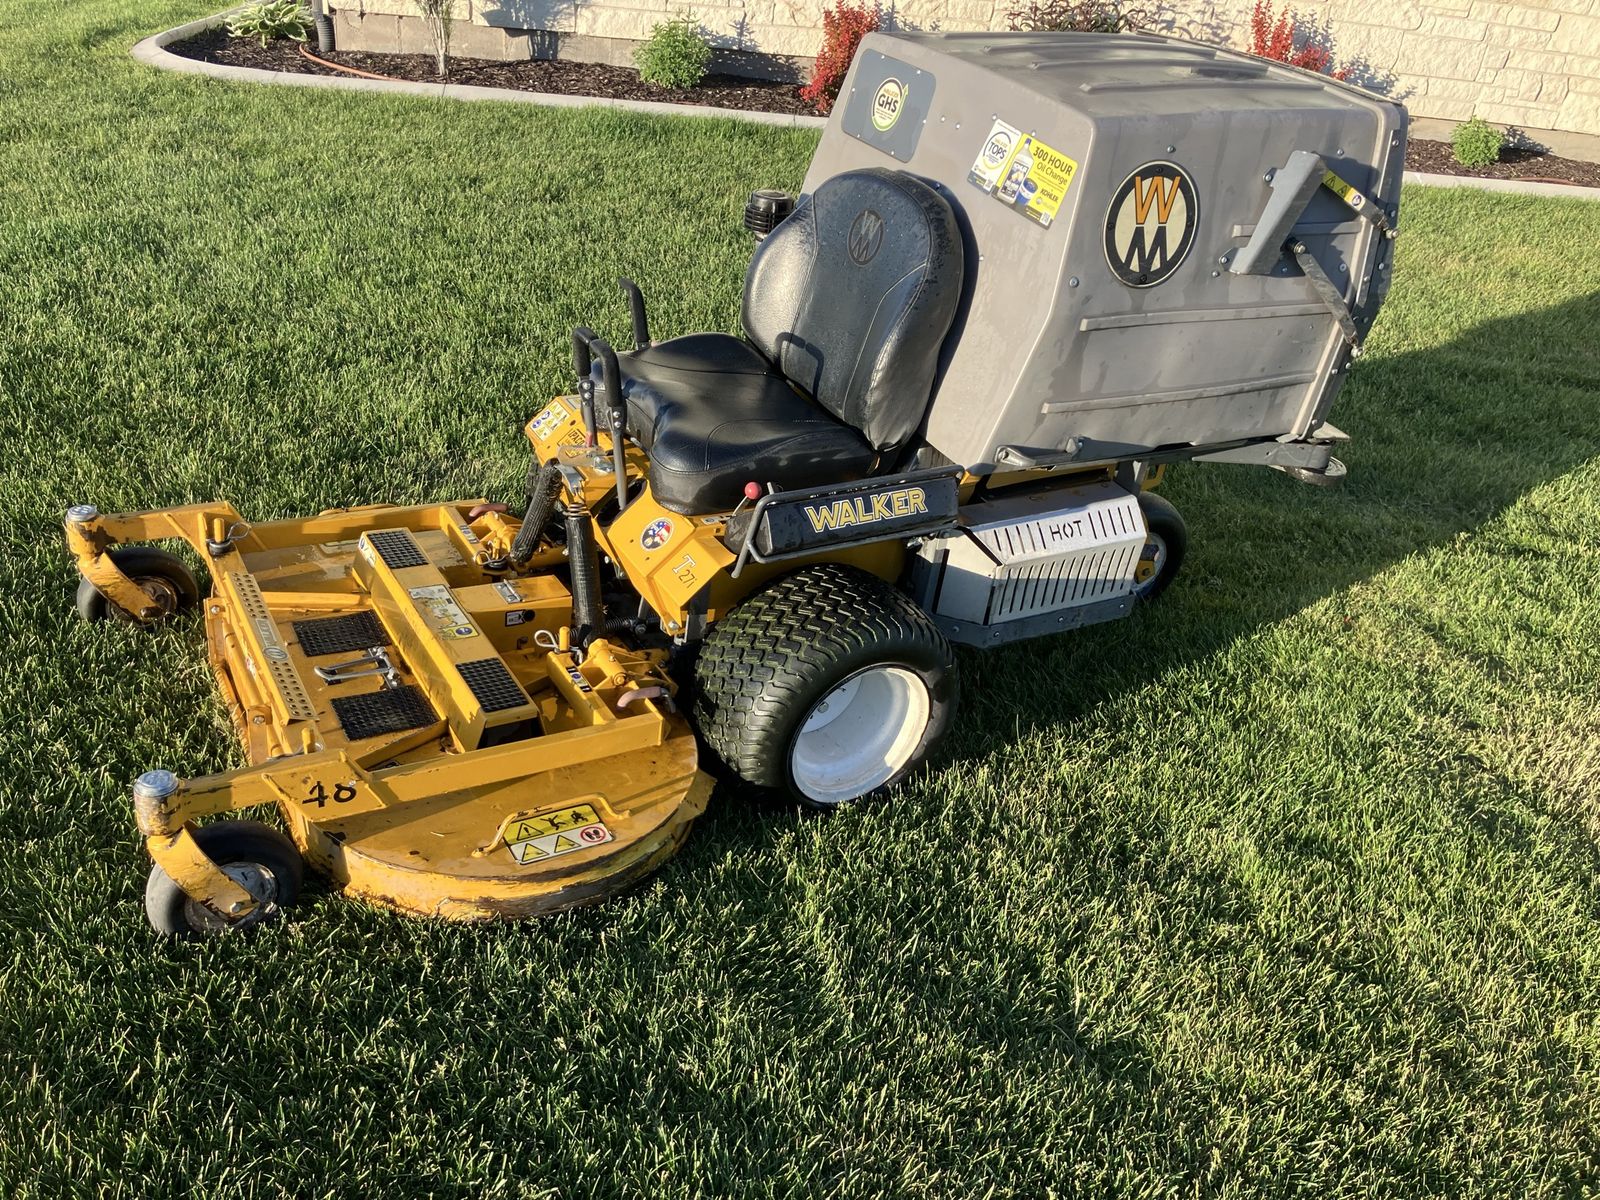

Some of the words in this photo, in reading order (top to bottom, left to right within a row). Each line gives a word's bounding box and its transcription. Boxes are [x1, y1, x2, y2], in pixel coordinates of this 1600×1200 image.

[877, 93, 899, 113] GHS
[987, 141, 1007, 160] TOPS
[1033, 146, 1049, 161] 300
[1047, 155, 1073, 177] HOUR
[1036, 161, 1046, 172] Oil
[1045, 166, 1068, 186] Change
[804, 487, 928, 534] WALKER
[1049, 520, 1082, 542] HOT
